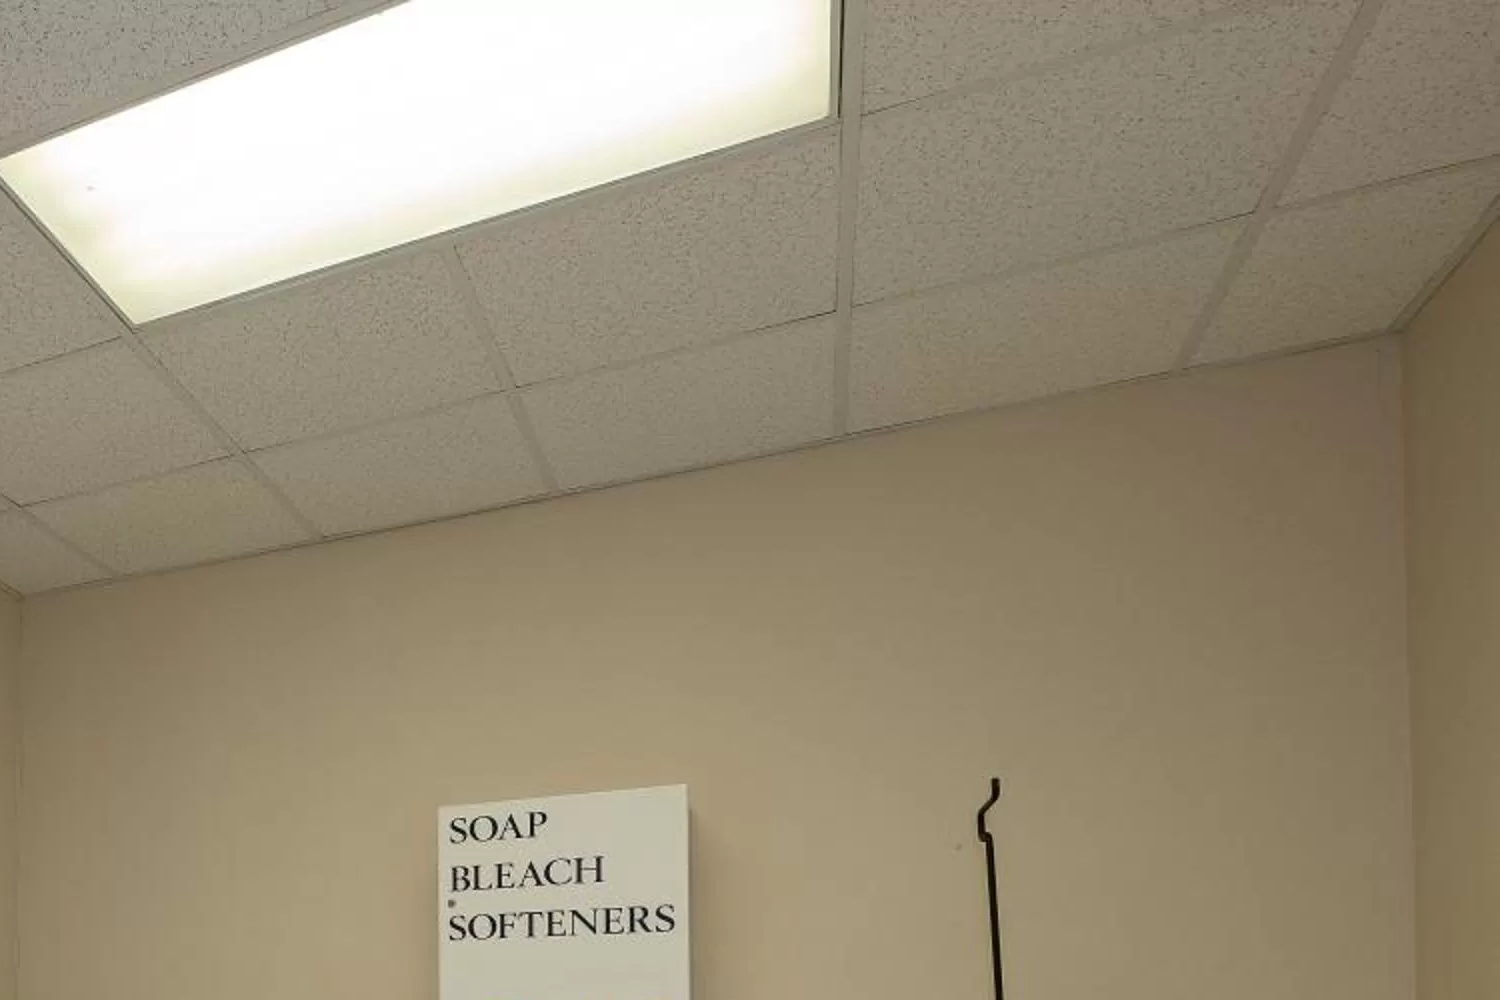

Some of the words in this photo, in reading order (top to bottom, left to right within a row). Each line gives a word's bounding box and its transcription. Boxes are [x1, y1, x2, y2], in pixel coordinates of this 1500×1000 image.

[449, 811, 548, 844] SOAP
[450, 855, 605, 892] BLEACH
[449, 904, 676, 941] SOFTENERS
